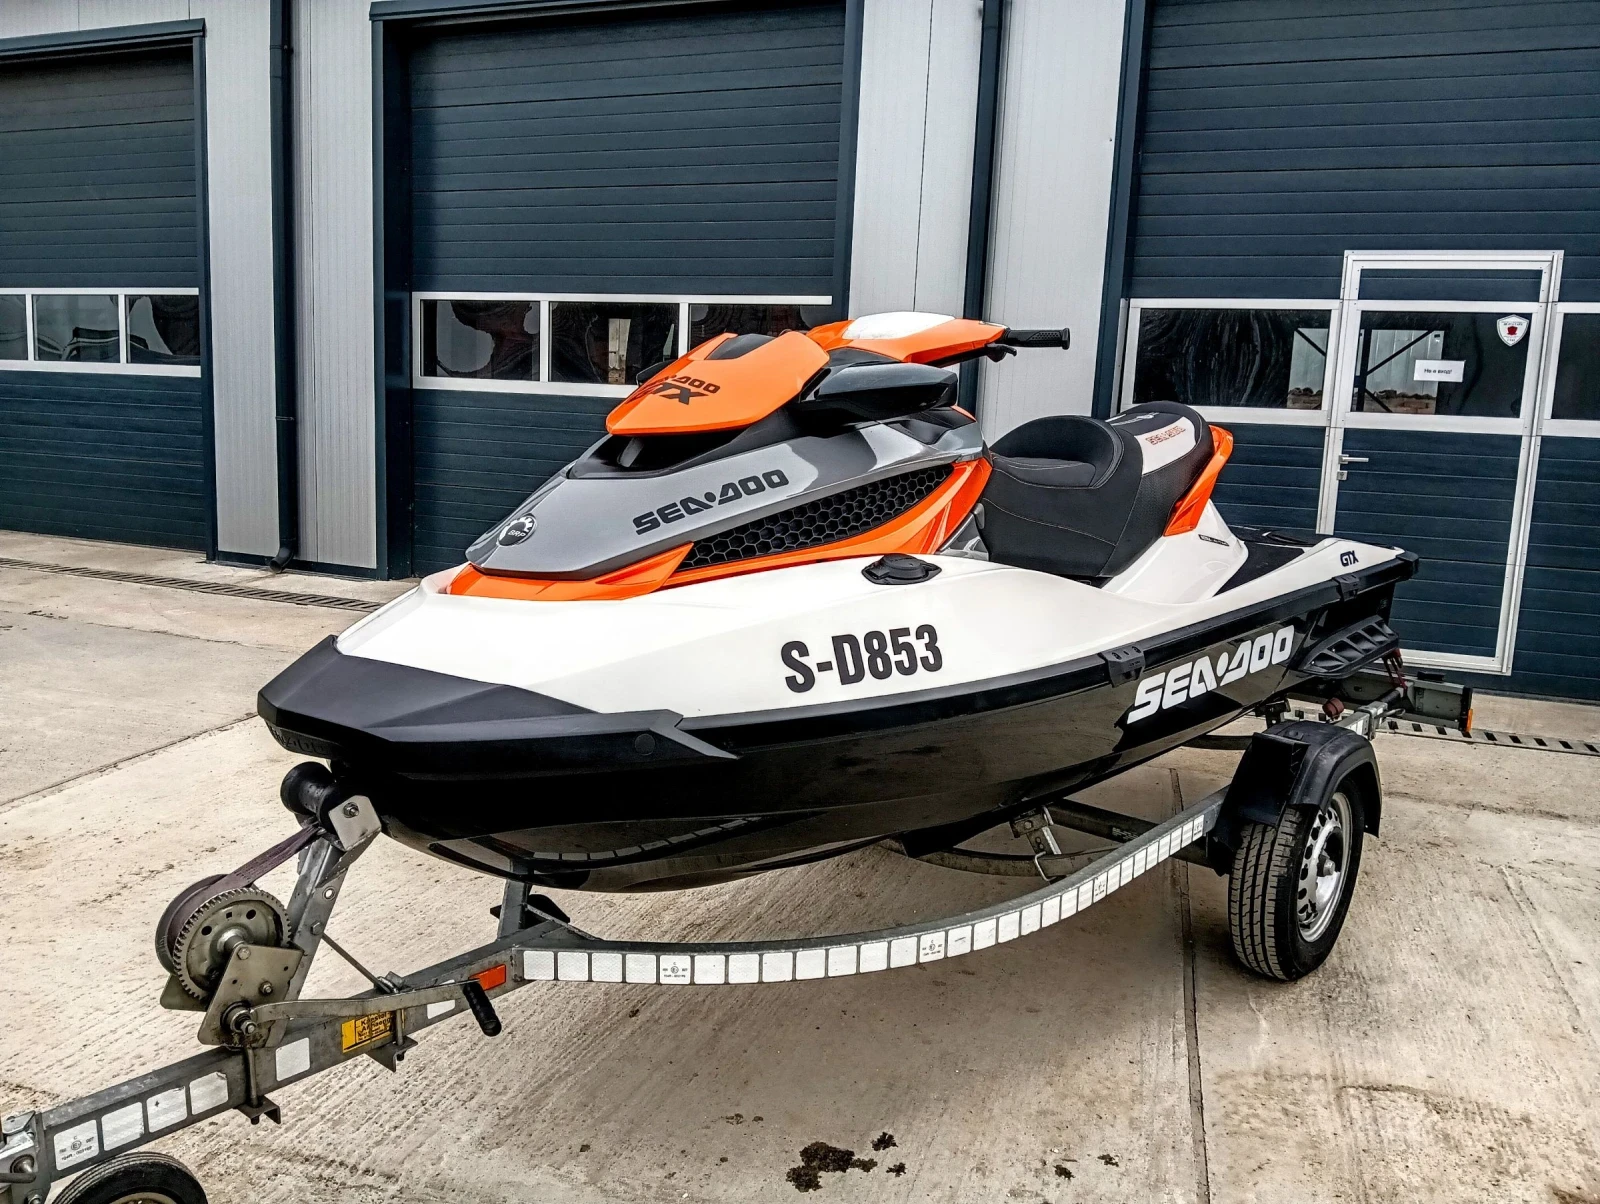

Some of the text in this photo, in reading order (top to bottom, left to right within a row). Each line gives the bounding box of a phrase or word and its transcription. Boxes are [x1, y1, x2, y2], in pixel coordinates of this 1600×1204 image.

[507, 529, 527, 538] BRP
[1340, 550, 1359, 567] GTX
[780, 624, 943, 693] S-D853
